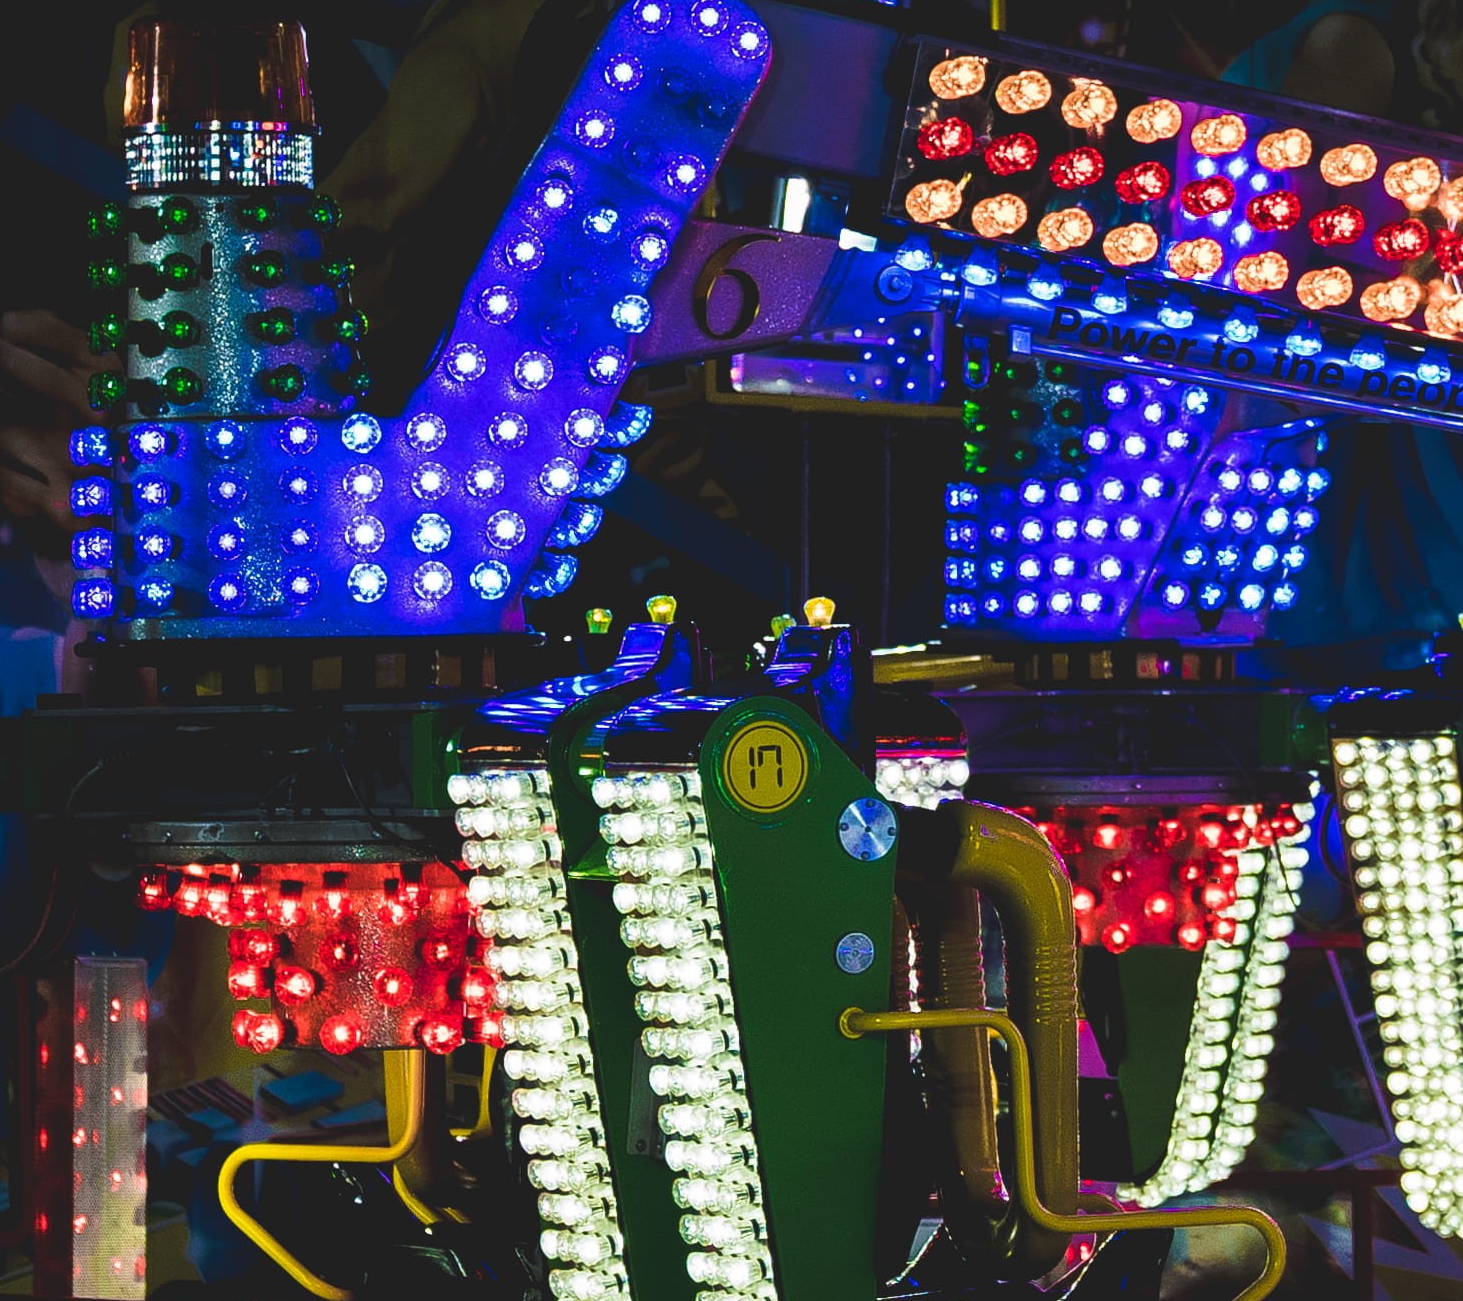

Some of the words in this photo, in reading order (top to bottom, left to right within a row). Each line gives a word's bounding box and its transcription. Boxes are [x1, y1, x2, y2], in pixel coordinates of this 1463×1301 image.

[694, 234, 781, 340] 6
[1048, 305, 1197, 361] Power
[1211, 335, 1256, 373] to
[1273, 347, 1344, 388] the
[749, 745, 783, 790] 17
